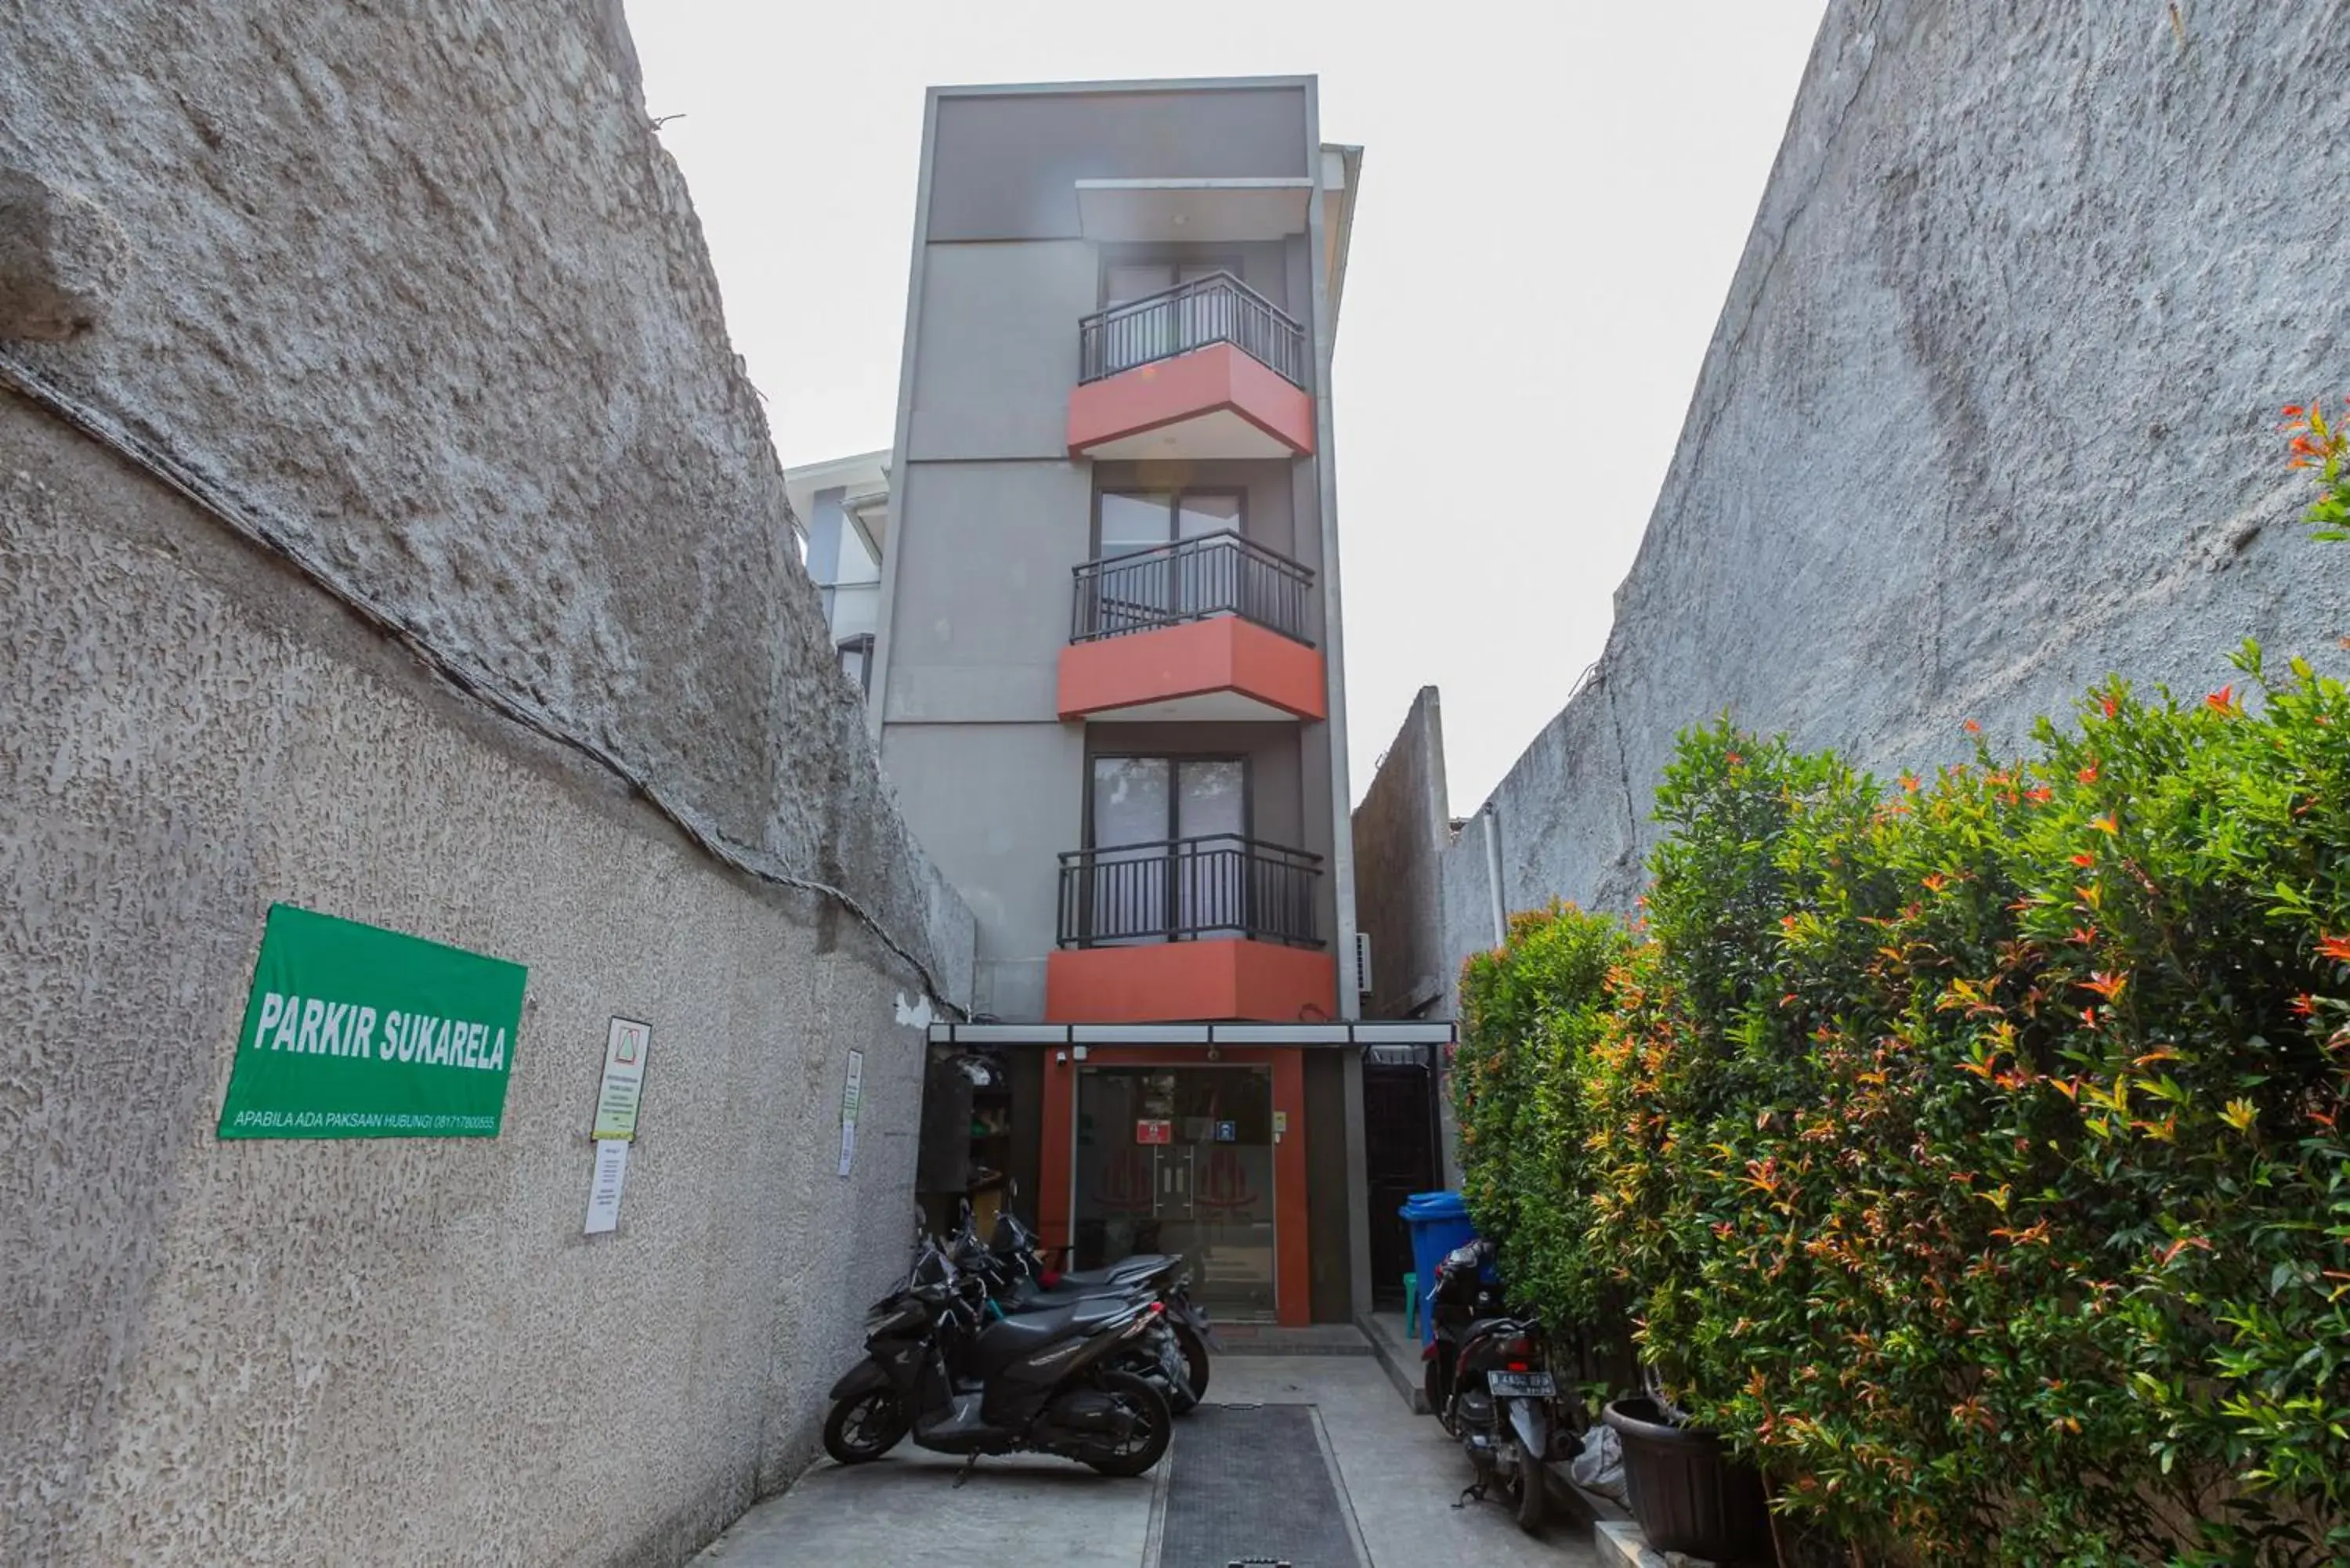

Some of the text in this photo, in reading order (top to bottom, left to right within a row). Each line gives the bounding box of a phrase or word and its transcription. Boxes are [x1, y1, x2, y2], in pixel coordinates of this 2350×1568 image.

[254, 992, 505, 1070] PARKIR SUKARELA
[233, 1110, 294, 1128] APABILA
[294, 1111, 324, 1128] ADA
[325, 1112, 382, 1129] PAKSAAN
[383, 1114, 432, 1129] HUBUNGI
